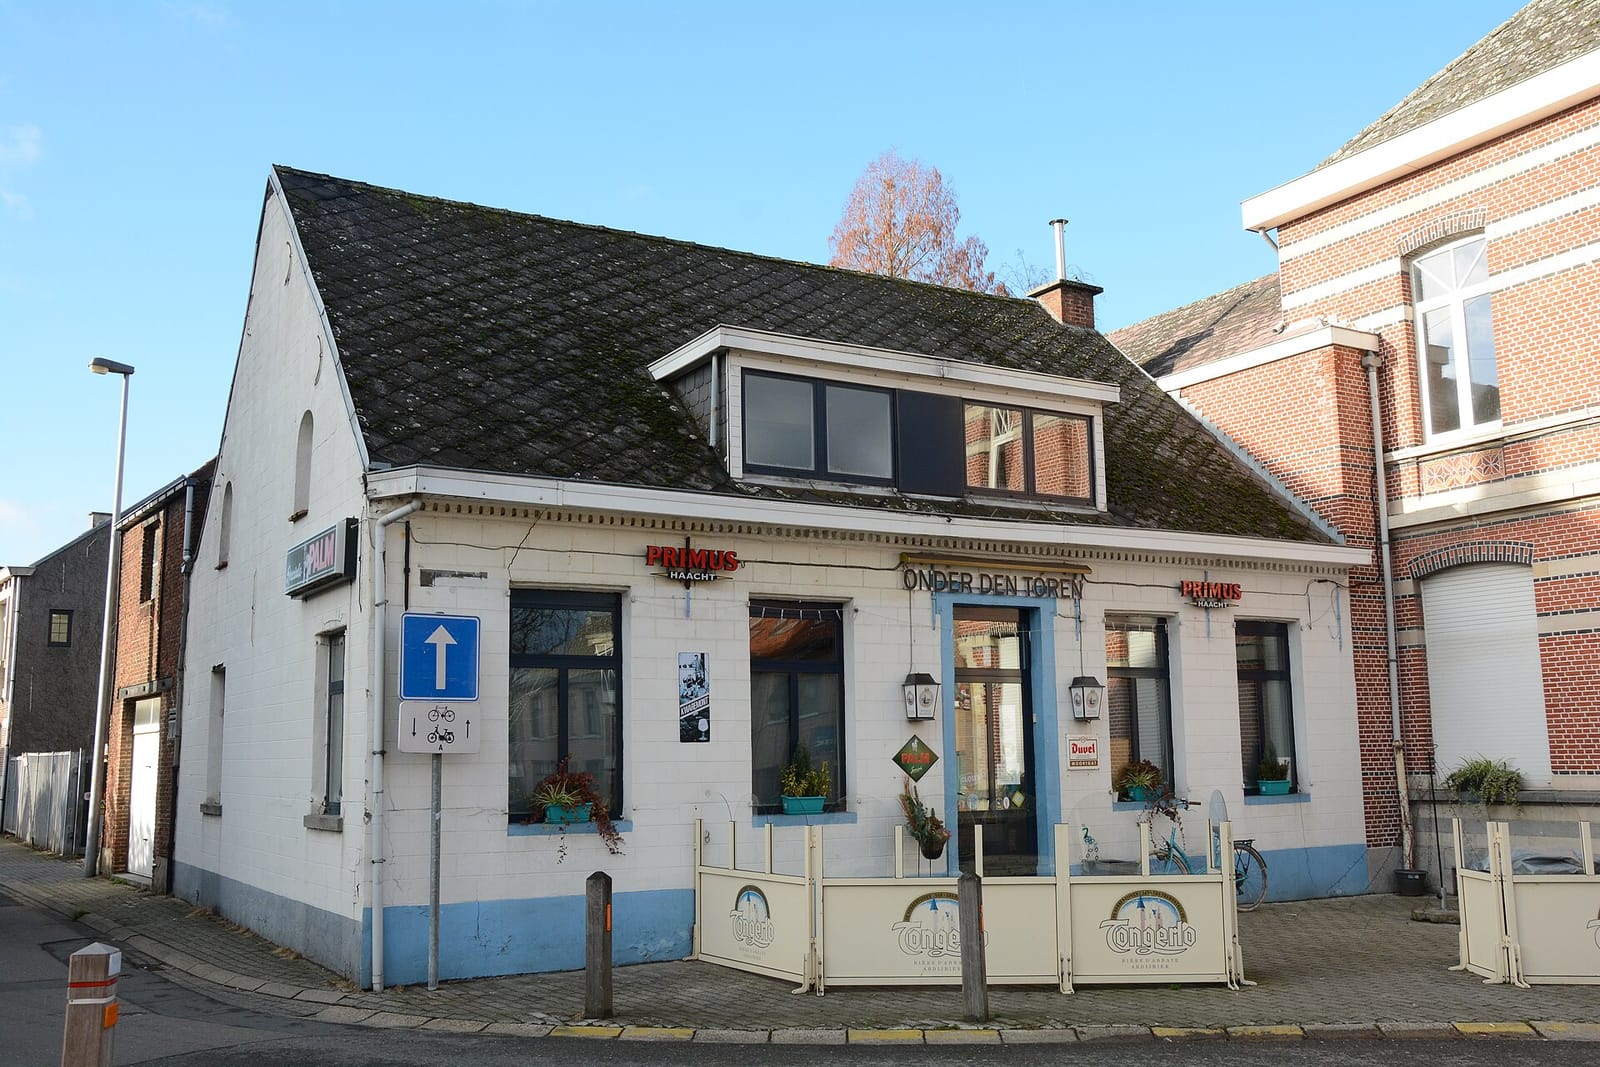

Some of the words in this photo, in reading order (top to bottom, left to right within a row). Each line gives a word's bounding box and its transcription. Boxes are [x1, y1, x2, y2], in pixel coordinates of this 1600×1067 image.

[308, 531, 335, 577] PALM
[645, 545, 739, 571] PRIMUS
[670, 571, 716, 581] HAACHT
[903, 568, 973, 593] ONDER
[980, 573, 1017, 596] DEN
[1022, 576, 1083, 599] TOREN
[1181, 580, 1242, 601] PRIMUS
[1197, 601, 1228, 609] HAACHT
[901, 752, 931, 764] PALM
[1071, 744, 1096, 754] Duvel
[730, 909, 775, 948] Tongerlo
[1099, 919, 1197, 955] Tongerlo
